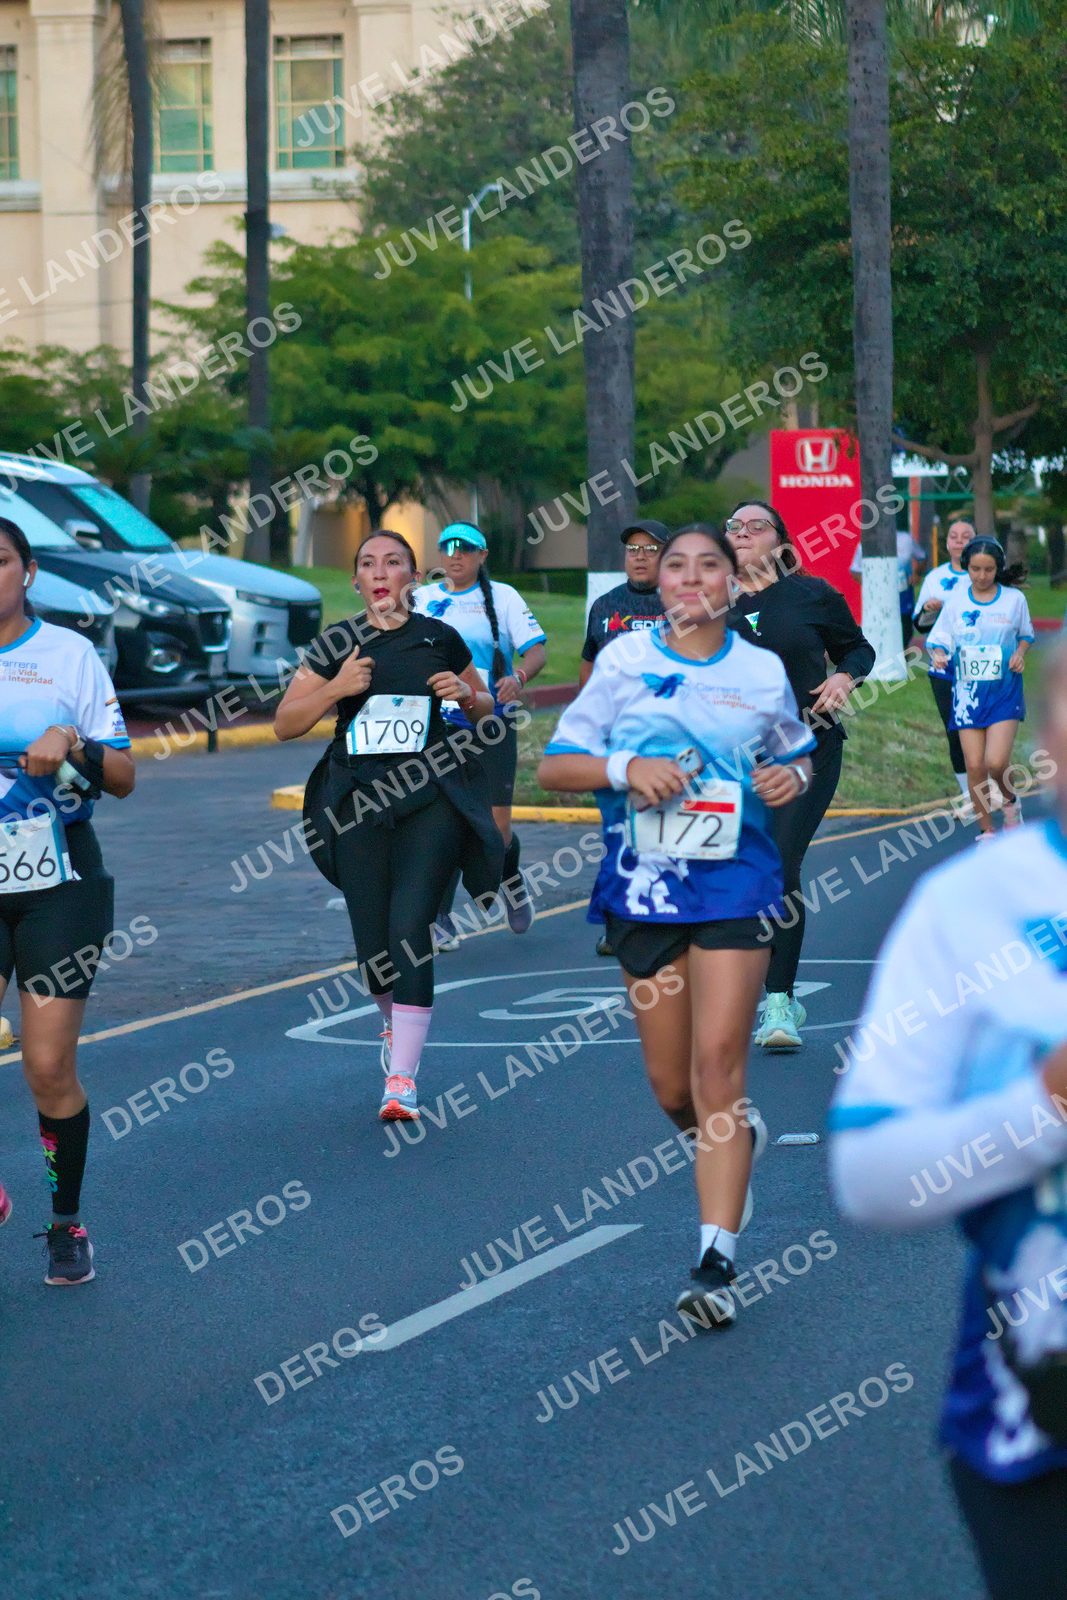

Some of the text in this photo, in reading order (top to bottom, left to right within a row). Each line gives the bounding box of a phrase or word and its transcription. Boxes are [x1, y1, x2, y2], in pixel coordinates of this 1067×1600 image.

[779, 474, 854, 488] HONDA
[0, 659, 38, 670] arrera
[962, 660, 1000, 676] 1875
[8, 675, 53, 684] Integridad
[18, 669, 38, 677] Vida
[360, 720, 424, 745] 1709
[656, 810, 723, 847] 172
